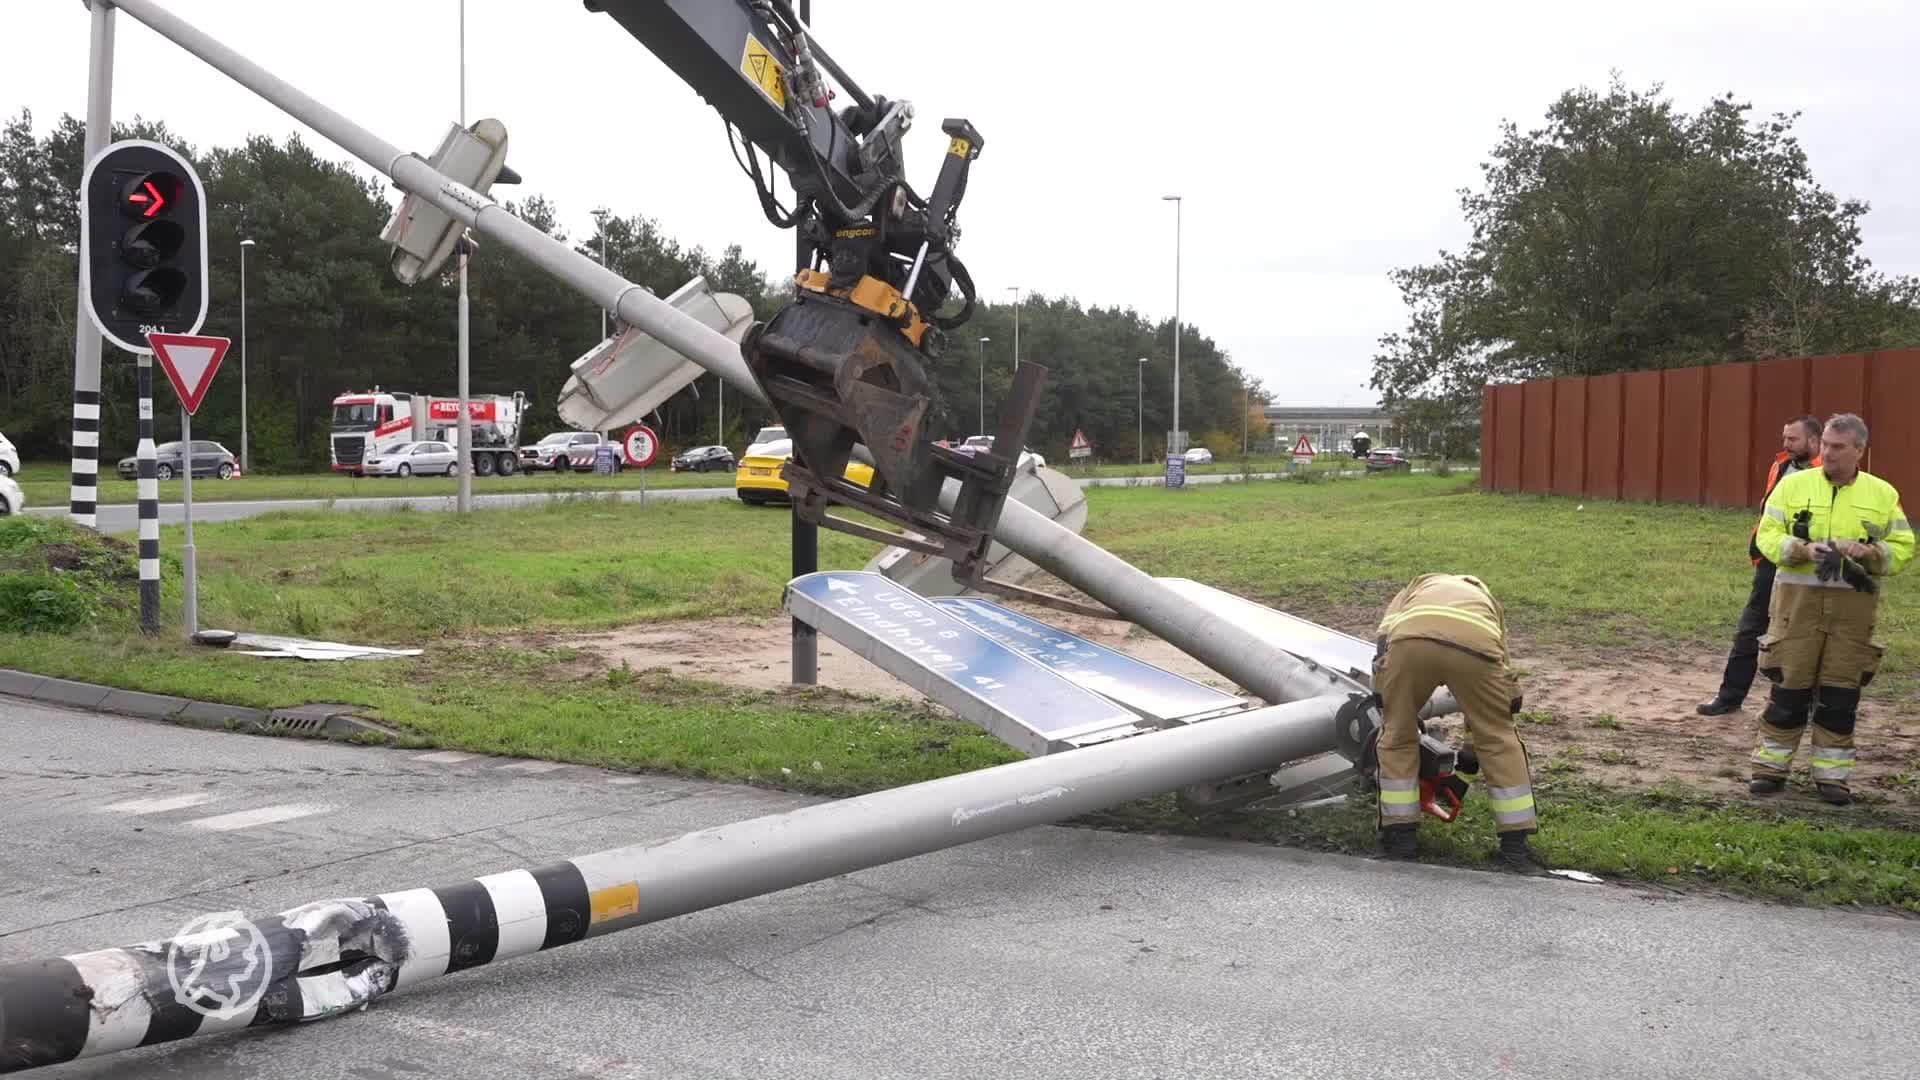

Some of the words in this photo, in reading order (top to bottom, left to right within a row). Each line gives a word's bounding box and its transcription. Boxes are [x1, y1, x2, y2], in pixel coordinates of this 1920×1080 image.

[873, 592, 936, 626] Uden
[836, 597, 969, 672] Eindhoven
[973, 676, 1006, 690] 41
